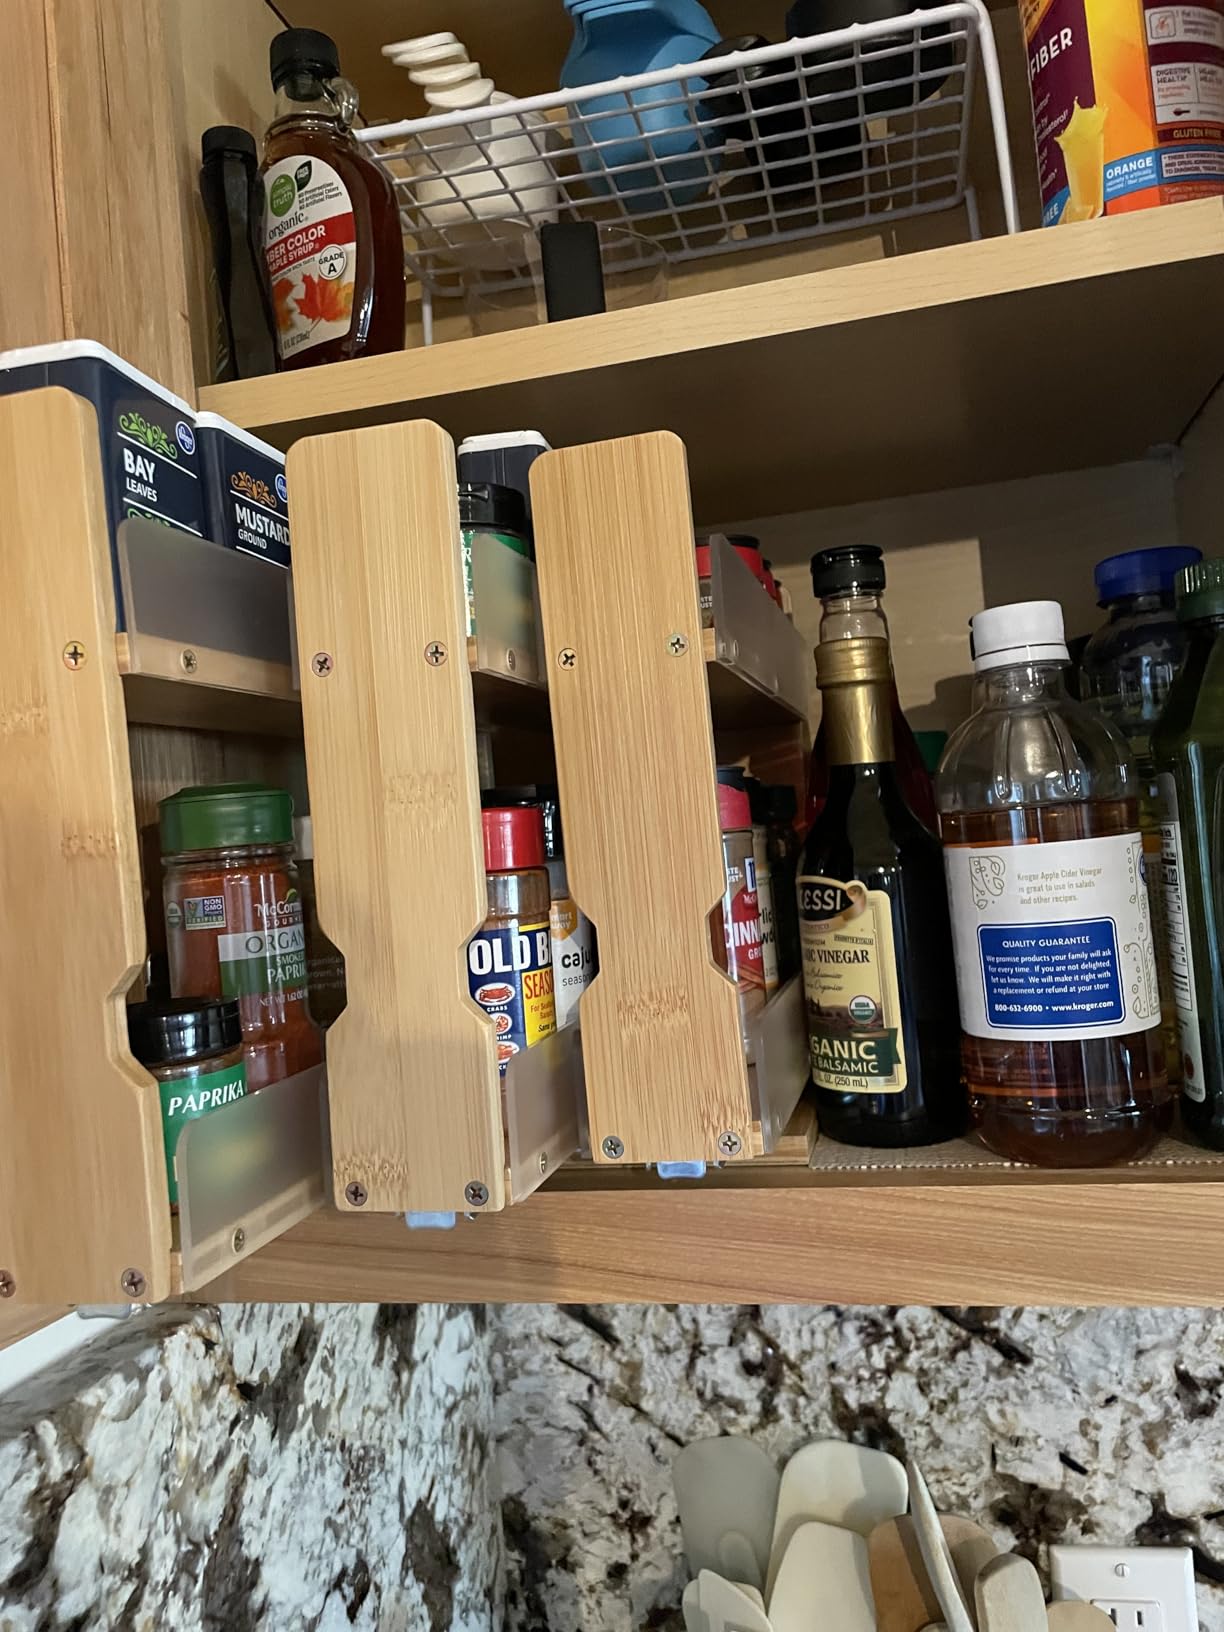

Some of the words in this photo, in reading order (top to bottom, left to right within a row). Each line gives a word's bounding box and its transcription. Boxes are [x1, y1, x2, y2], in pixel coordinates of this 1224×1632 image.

[1030, 27, 1072, 81] FIBER
[1173, 128, 1203, 138] GLUTEN
[1106, 156, 1153, 180] ORANGE
[269, 211, 305, 240] organic
[287, 225, 326, 250] COLOR
[288, 242, 314, 261] SYRUP
[318, 252, 344, 265] GRADE
[328, 263, 337, 276] A
[123, 448, 156, 484] BAY
[126, 477, 158, 502] LEAVES
[235, 503, 290, 547] MUSTARD
[237, 528, 268, 550] GROUND
[1017, 872, 1039, 882] Kroger
[1040, 871, 1060, 881] Apple
[1060, 869, 1078, 878] Cider
[1079, 867, 1102, 877] Vinegar
[1026, 884, 1044, 894] great
[1045, 883, 1053, 891] to
[1054, 883, 1066, 891] use
[1075, 880, 1095, 888] salads
[1020, 896, 1032, 904] and
[1033, 895, 1051, 904] other
[1002, 939, 1036, 948] QUALITY
[1038, 935, 1090, 947] GUARANTEE
[469, 934, 531, 976] OLD
[536, 928, 553, 967] B
[561, 945, 591, 970] caju
[817, 949, 870, 964] VINEGAR
[996, 956, 1019, 964] promise
[1020, 954, 1050, 964] products
[1051, 954, 1067, 963] your
[1068, 951, 1089, 961] family
[1090, 949, 1101, 958] will
[1102, 948, 1112, 957] ask
[988, 965, 997, 973] for
[997, 966, 1014, 975] every
[1015, 965, 1031, 973] time.
[1034, 964, 1041, 973] If
[1041, 965, 1054, 975] you
[1067, 963, 1079, 971] not
[991, 975, 999, 984] let
[1007, 976, 1025, 984] know.
[1028, 976, 1040, 984] We
[1040, 975, 1053, 983] will
[1054, 974, 1073, 983] make
[1080, 972, 1096, 982] right
[1097, 970, 1111, 979] with
[997, 986, 1035, 996] replacement
[1045, 985, 1068, 994] refund
[1069, 985, 1076, 993] at
[1077, 985, 1092, 994] your
[1093, 983, 1110, 991] store
[260, 996, 273, 1006] NET
[994, 1003, 1043, 1012] 800-632-6900
[1051, 1001, 1114, 1012] www.kroger.com
[811, 1035, 877, 1060] GANIC
[818, 1056, 879, 1074] BALSAMIC
[834, 1075, 850, 1088] (250
[852, 1077, 869, 1089] mL)
[167, 1079, 244, 1117] PAPRIKA
